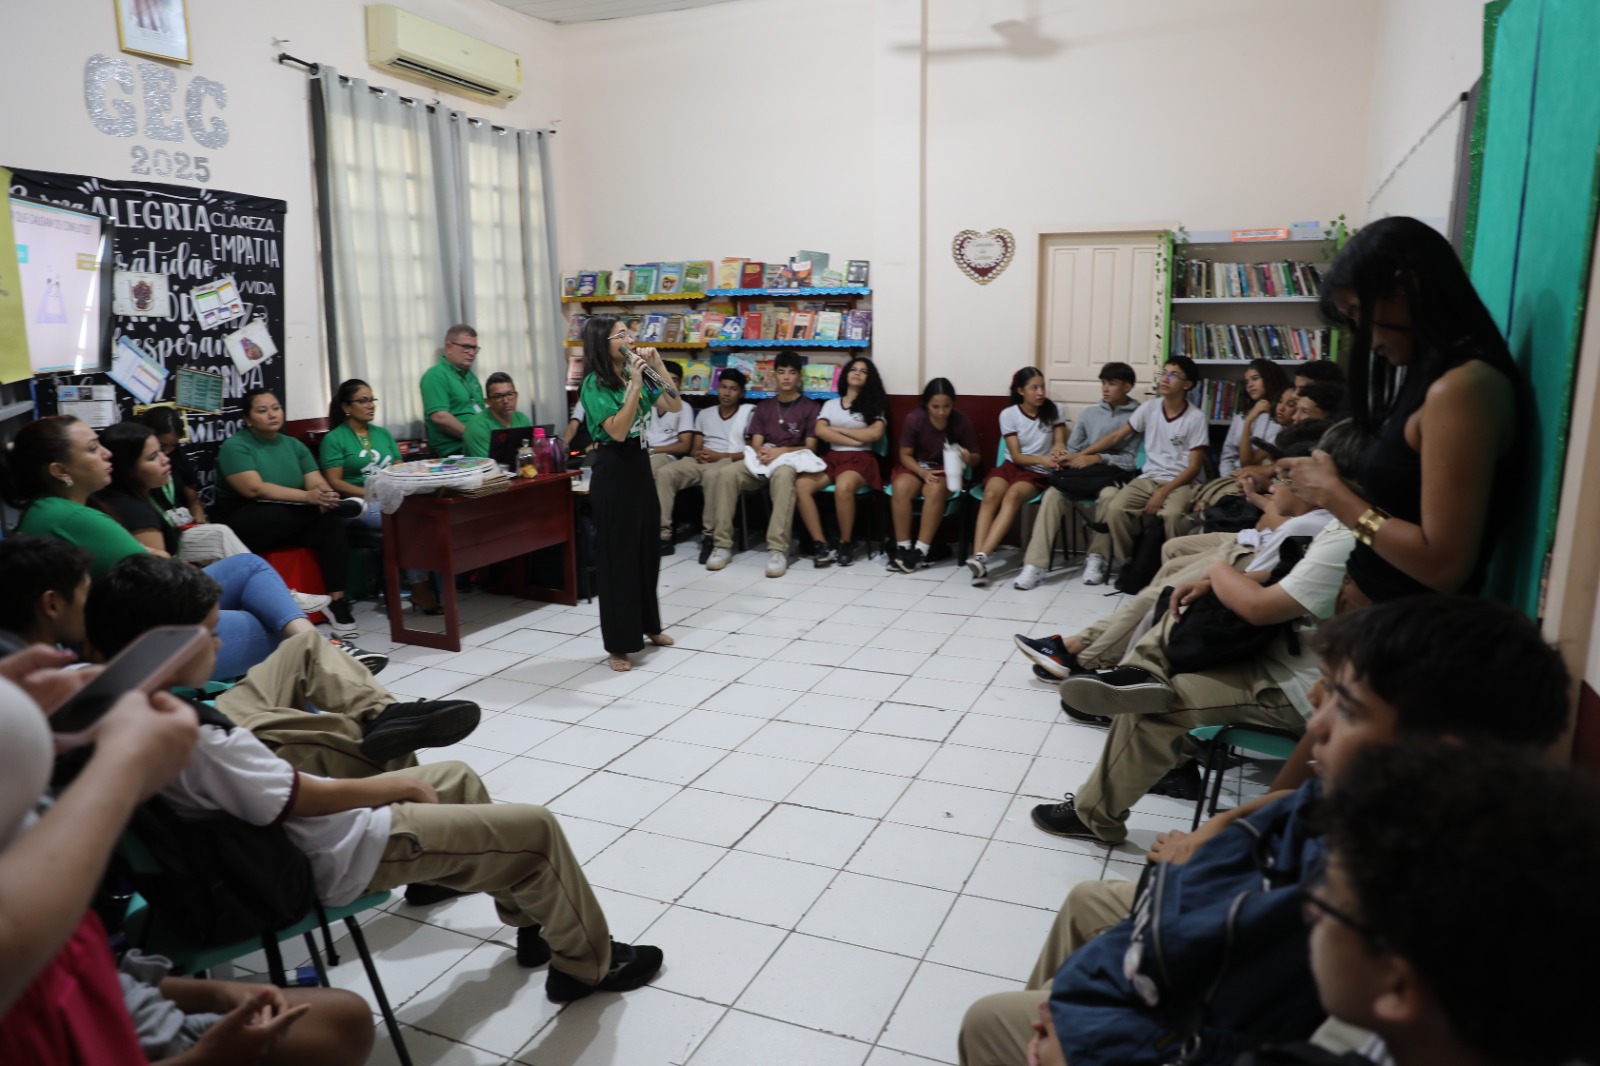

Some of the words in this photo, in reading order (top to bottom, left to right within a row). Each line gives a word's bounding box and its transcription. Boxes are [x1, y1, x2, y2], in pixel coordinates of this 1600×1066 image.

[130, 145, 211, 183] 2025
[92, 196, 212, 233] ALEGRIA
[209, 212, 276, 233] CLAREZA
[114, 241, 218, 281] ratidão
[210, 233, 281, 269] EMPATIA
